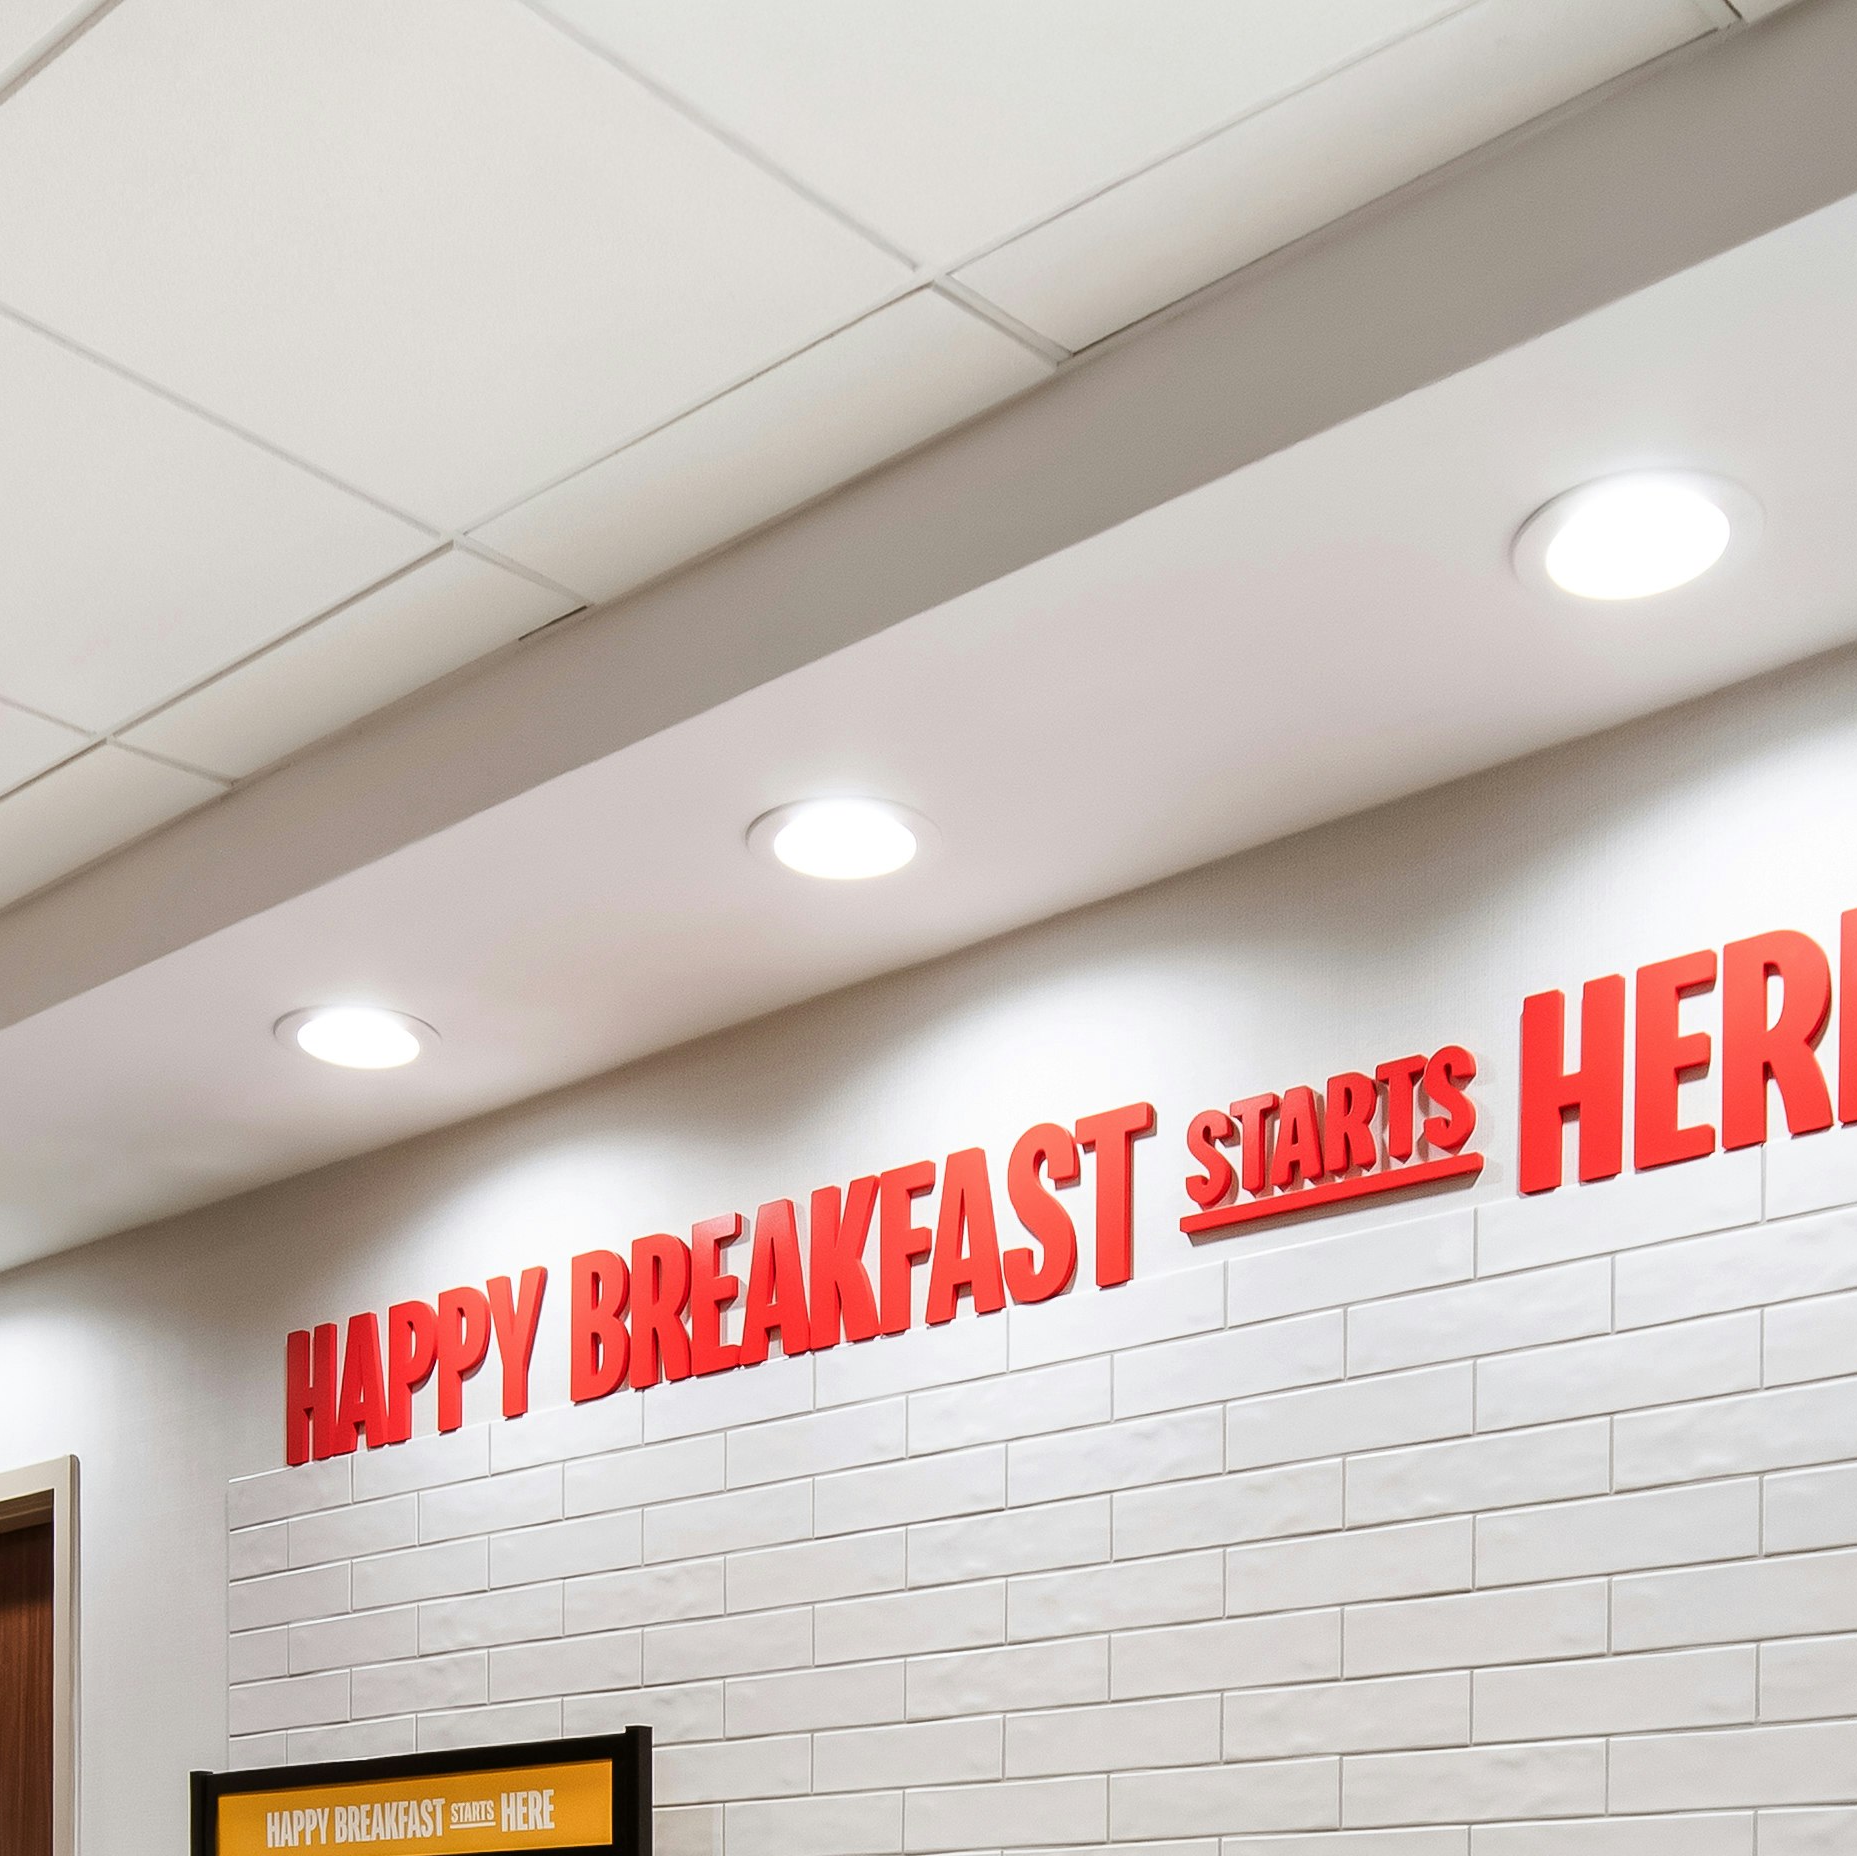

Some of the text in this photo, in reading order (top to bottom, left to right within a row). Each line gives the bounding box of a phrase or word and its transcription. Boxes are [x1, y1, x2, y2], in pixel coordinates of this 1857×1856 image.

[286, 1266, 548, 1465] HAPPY
[570, 1102, 1156, 1404] BREAKFAST
[1186, 1045, 1480, 1208] STARTS
[266, 1789, 555, 1849] HAPPY BREAKFAST STARTS HERE
